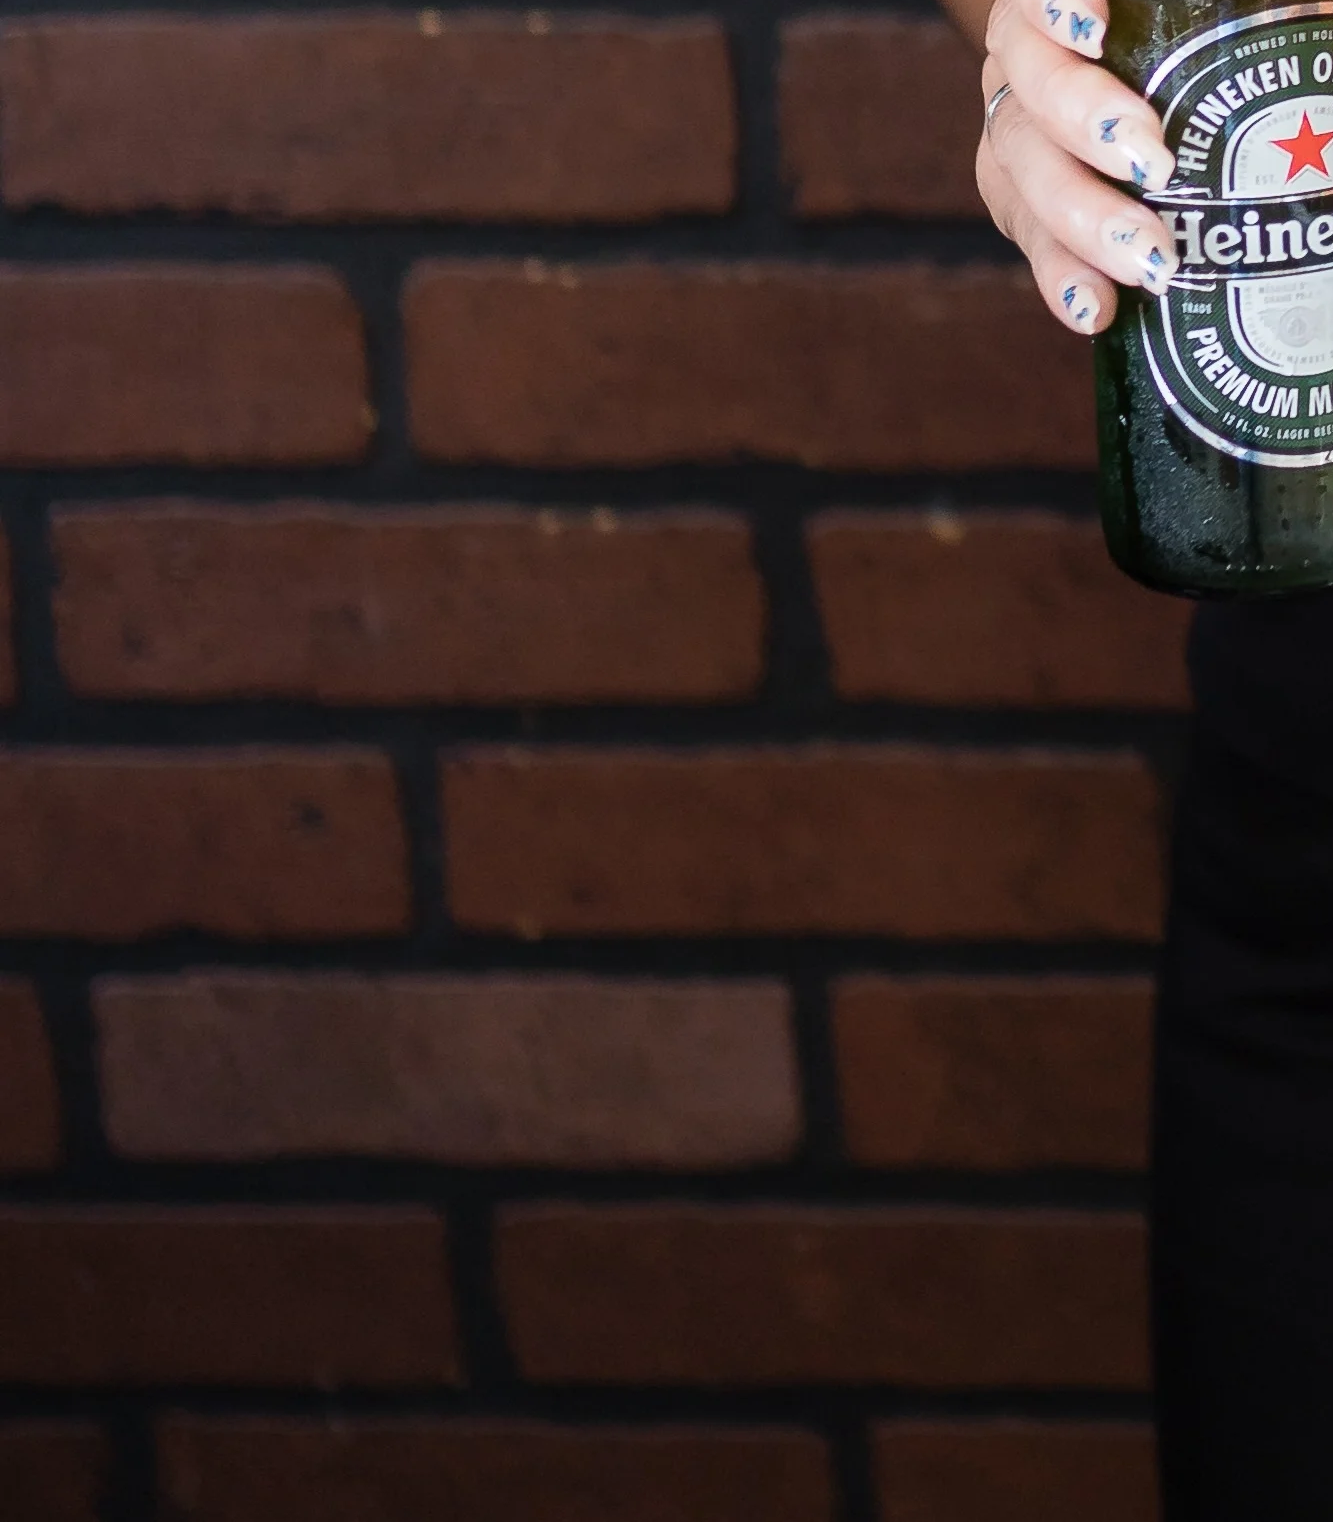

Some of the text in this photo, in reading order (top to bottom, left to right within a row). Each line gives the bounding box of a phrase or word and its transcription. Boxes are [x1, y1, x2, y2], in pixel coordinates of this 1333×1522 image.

[1234, 34, 1286, 59] BREWED
[1292, 31, 1307, 43] IN
[1177, 55, 1301, 172] HEINEKEN
[1187, 326, 1299, 418] PREMIUM
[1276, 427, 1310, 440] LAGER
